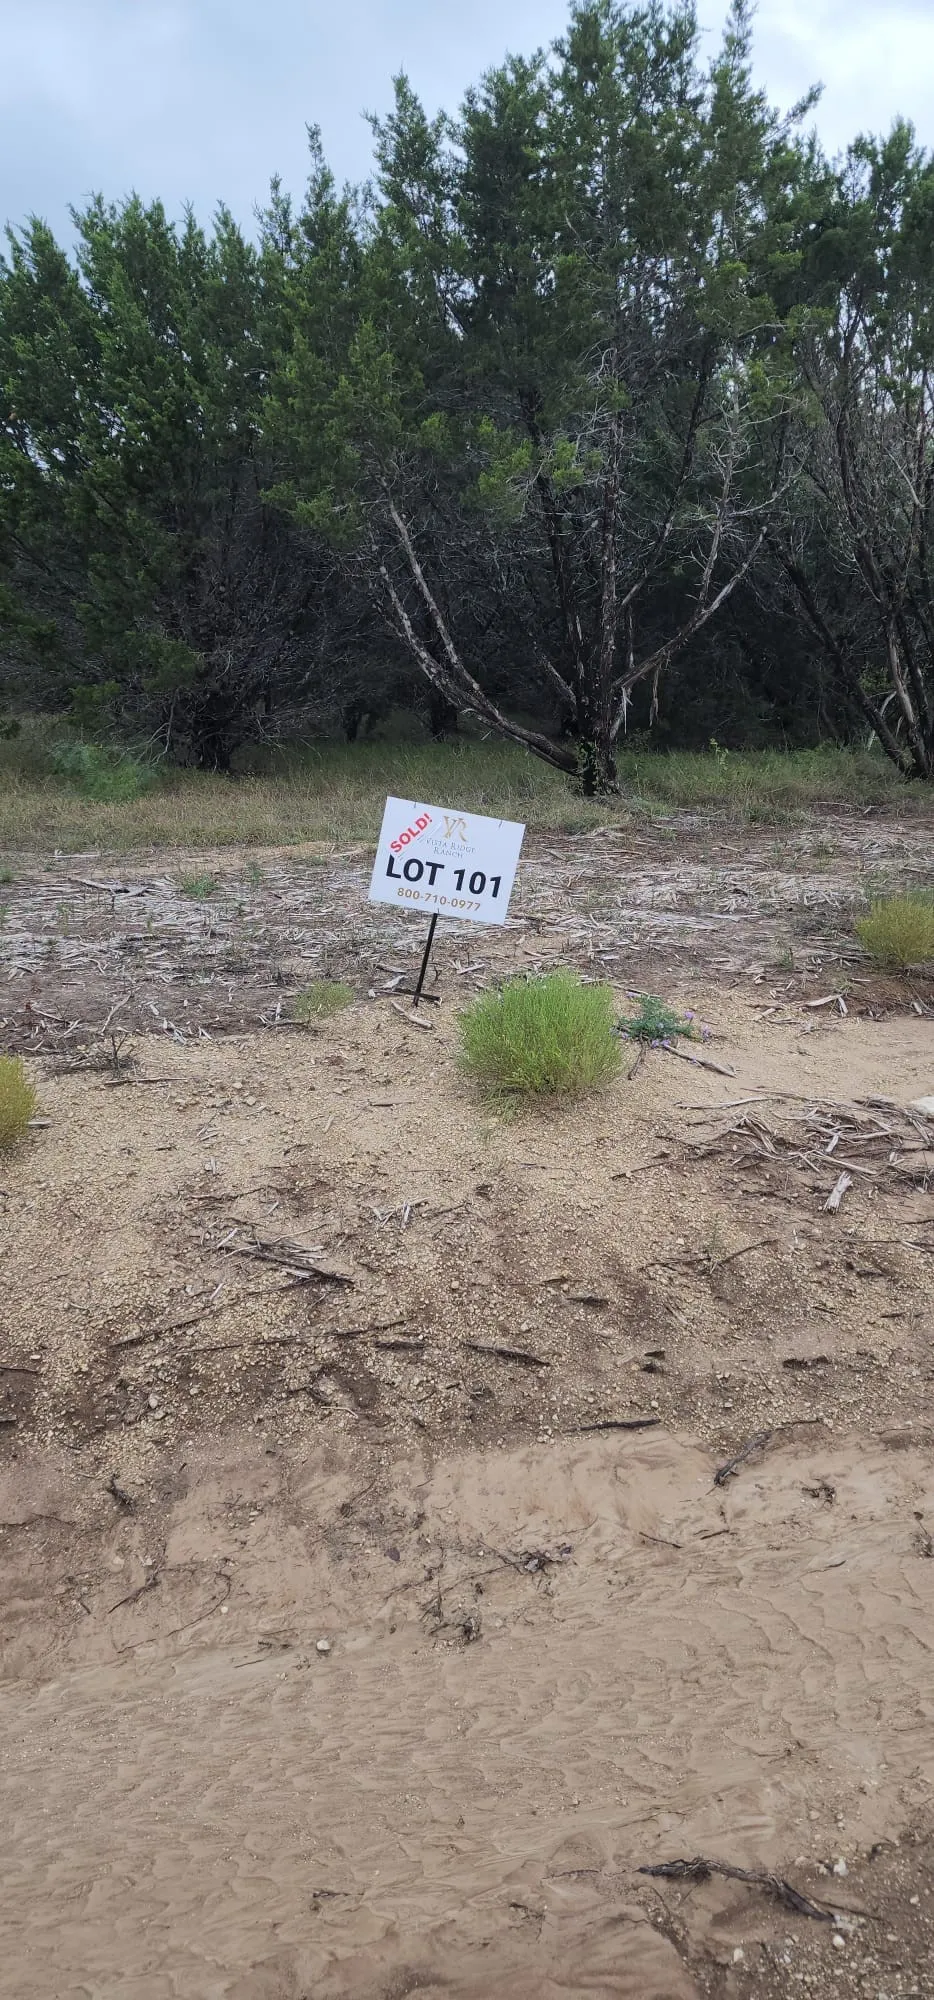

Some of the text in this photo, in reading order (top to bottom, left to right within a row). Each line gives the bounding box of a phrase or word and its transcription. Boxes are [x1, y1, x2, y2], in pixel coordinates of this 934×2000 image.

[390, 813, 433, 853] SOLD!
[386, 854, 502, 898] LOT 101
[397, 888, 481, 911] 800-710-0977
